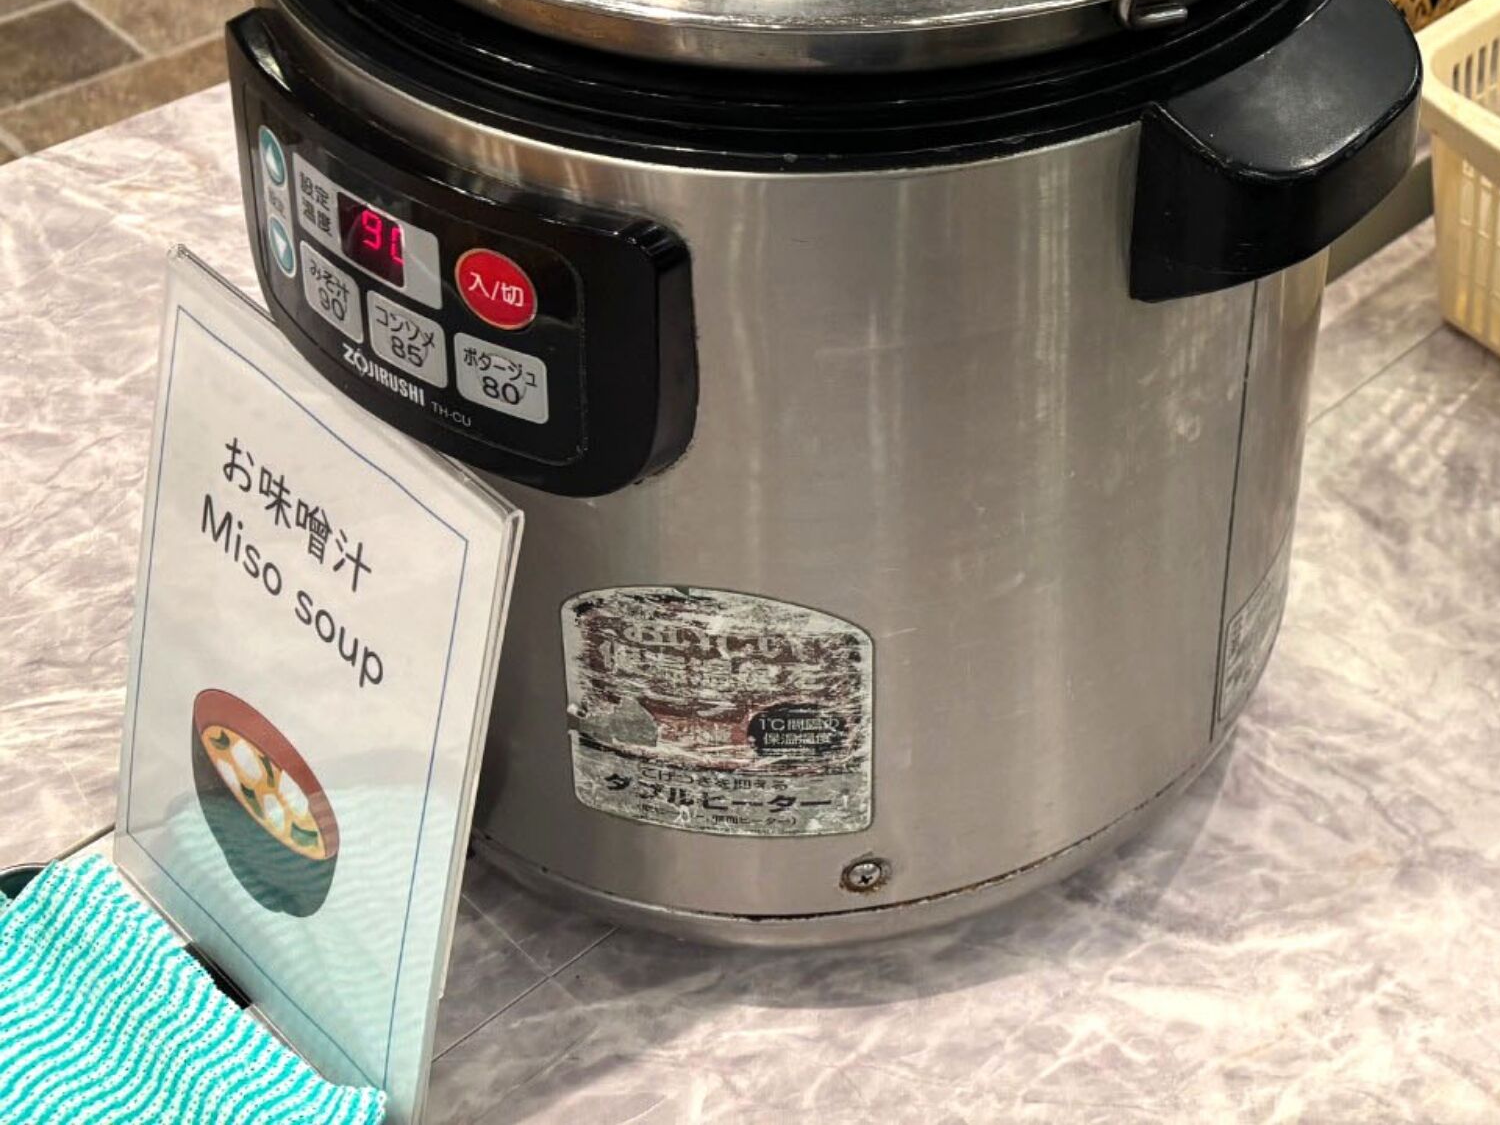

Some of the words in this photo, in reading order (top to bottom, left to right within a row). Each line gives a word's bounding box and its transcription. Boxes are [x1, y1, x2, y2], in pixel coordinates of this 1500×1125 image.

[299, 172, 331, 212] 設定
[302, 201, 334, 237] 温度
[308, 258, 350, 303] みそ汁
[467, 271, 525, 308] 入/切
[318, 287, 346, 322] 90
[374, 305, 437, 349] コンソメ
[390, 336, 424, 368] 85
[462, 347, 538, 387] ポタージュ
[481, 376, 520, 406] 80
[430, 400, 472, 428] TH-CU
[222, 437, 372, 593] お味噌汁
[201, 493, 282, 596] Miso
[294, 589, 384, 689] soup
